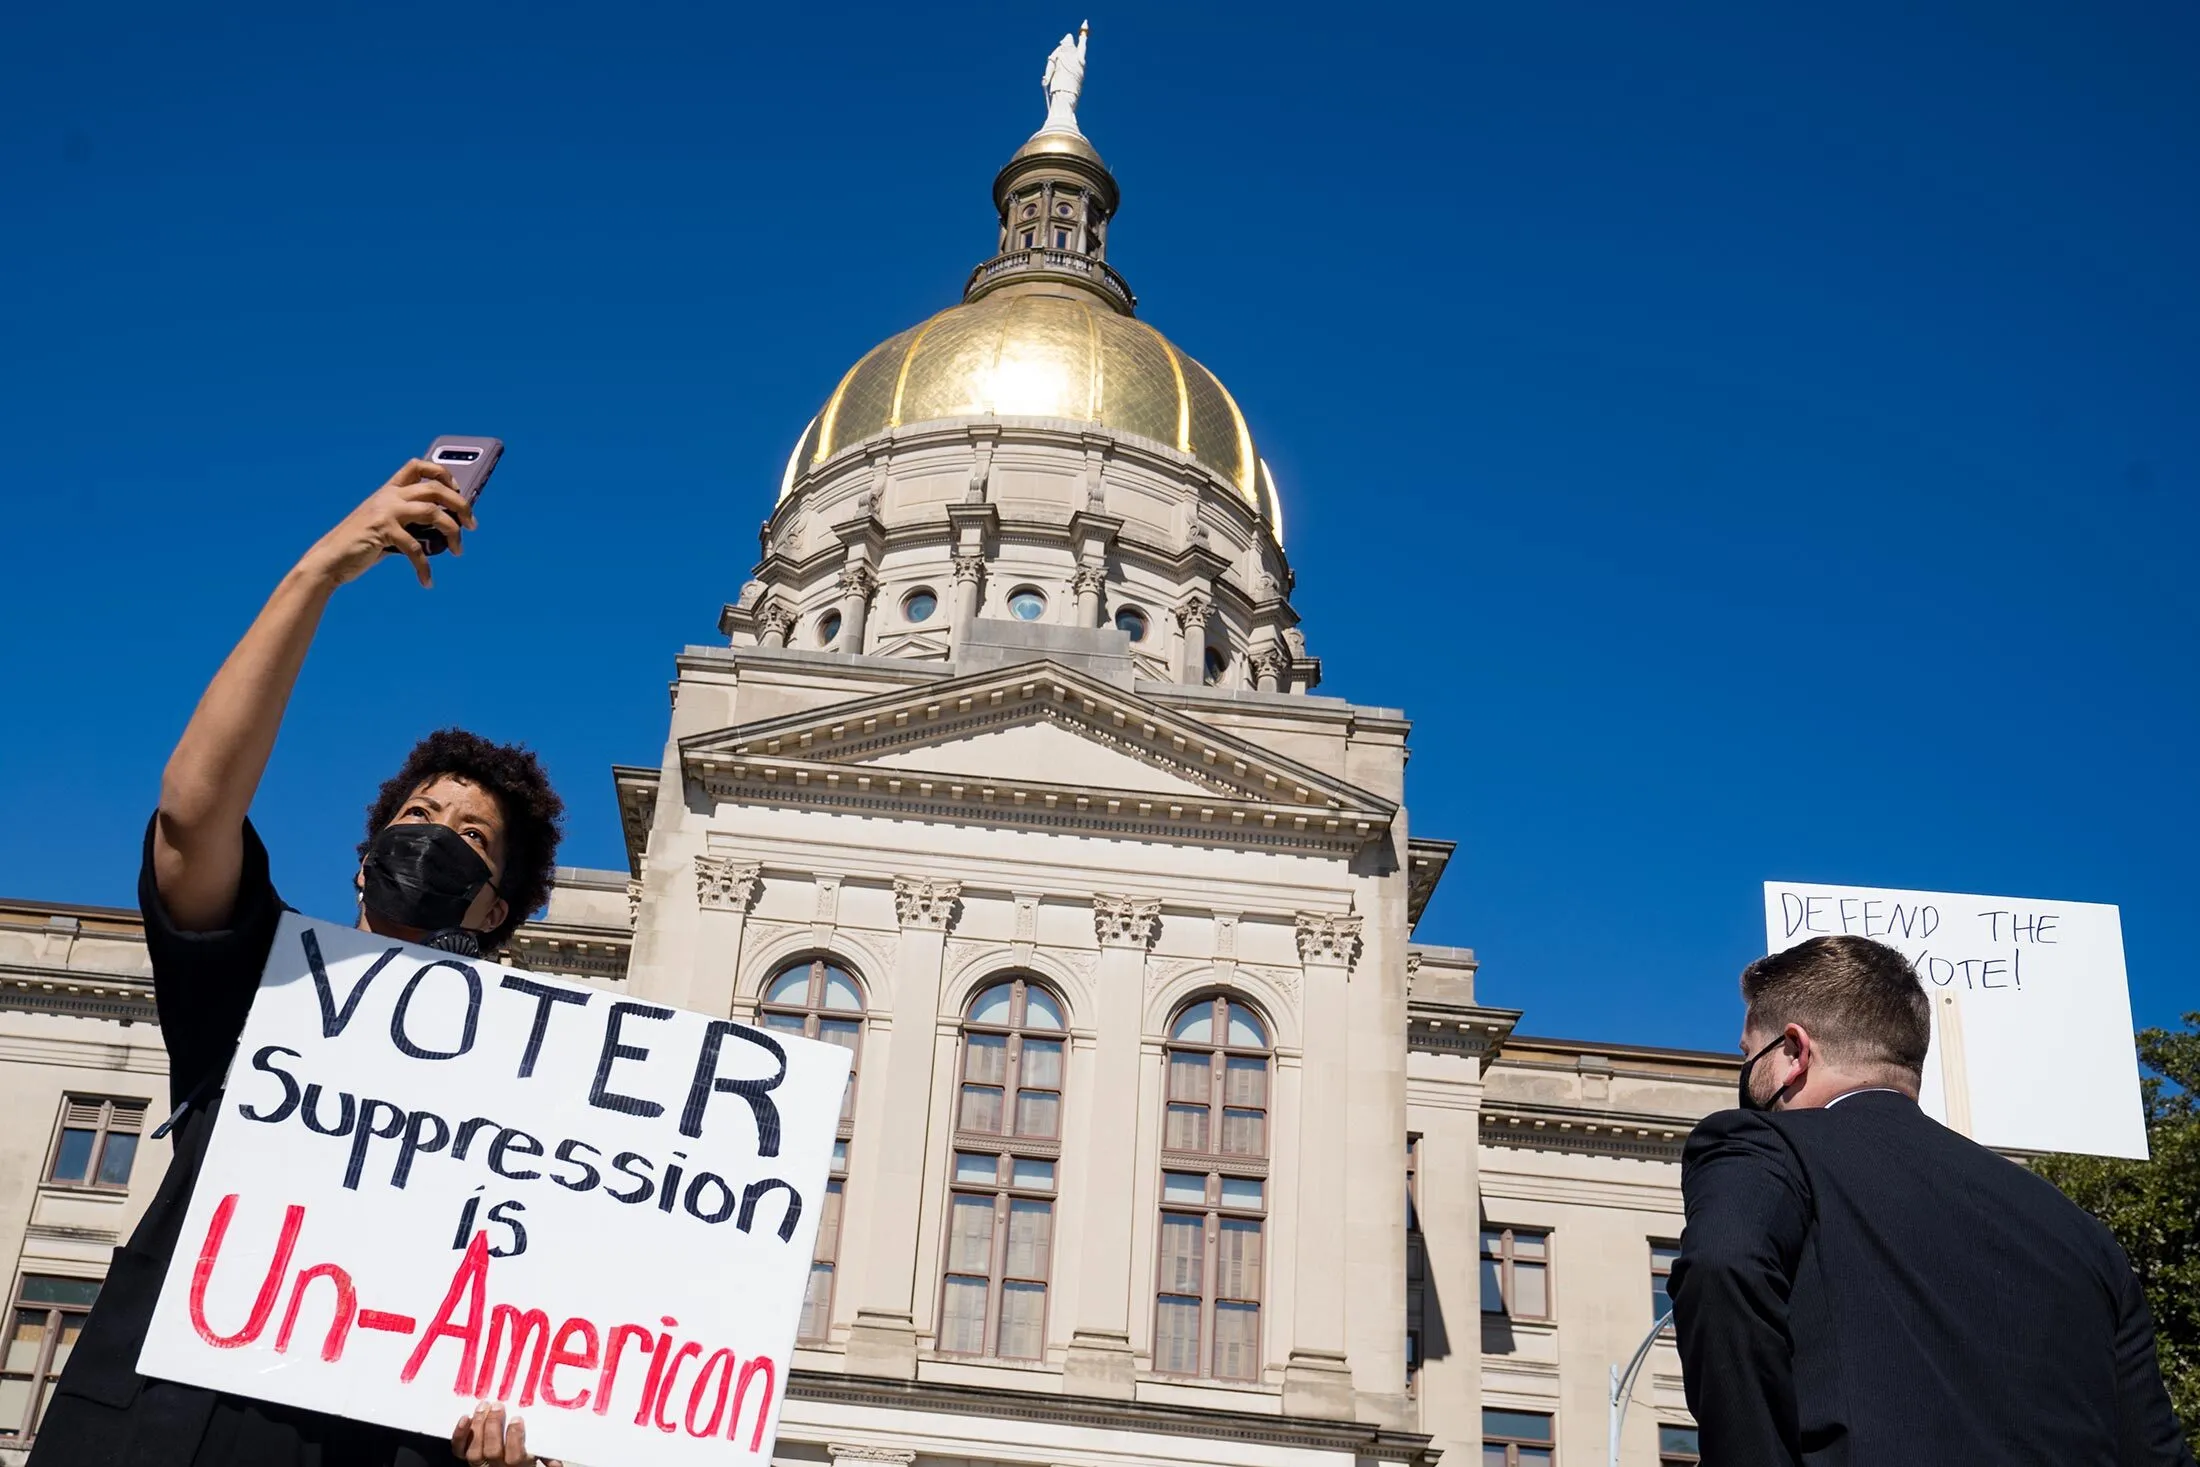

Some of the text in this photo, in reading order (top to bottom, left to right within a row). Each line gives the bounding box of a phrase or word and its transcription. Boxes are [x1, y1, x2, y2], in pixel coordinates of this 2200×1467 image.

[1781, 892, 2060, 944] DEFEND THE
[301, 928, 787, 1157] VOTER
[239, 1045, 802, 1243] Suppression
[452, 1185, 528, 1257] is
[189, 1194, 775, 1452] Un-American
